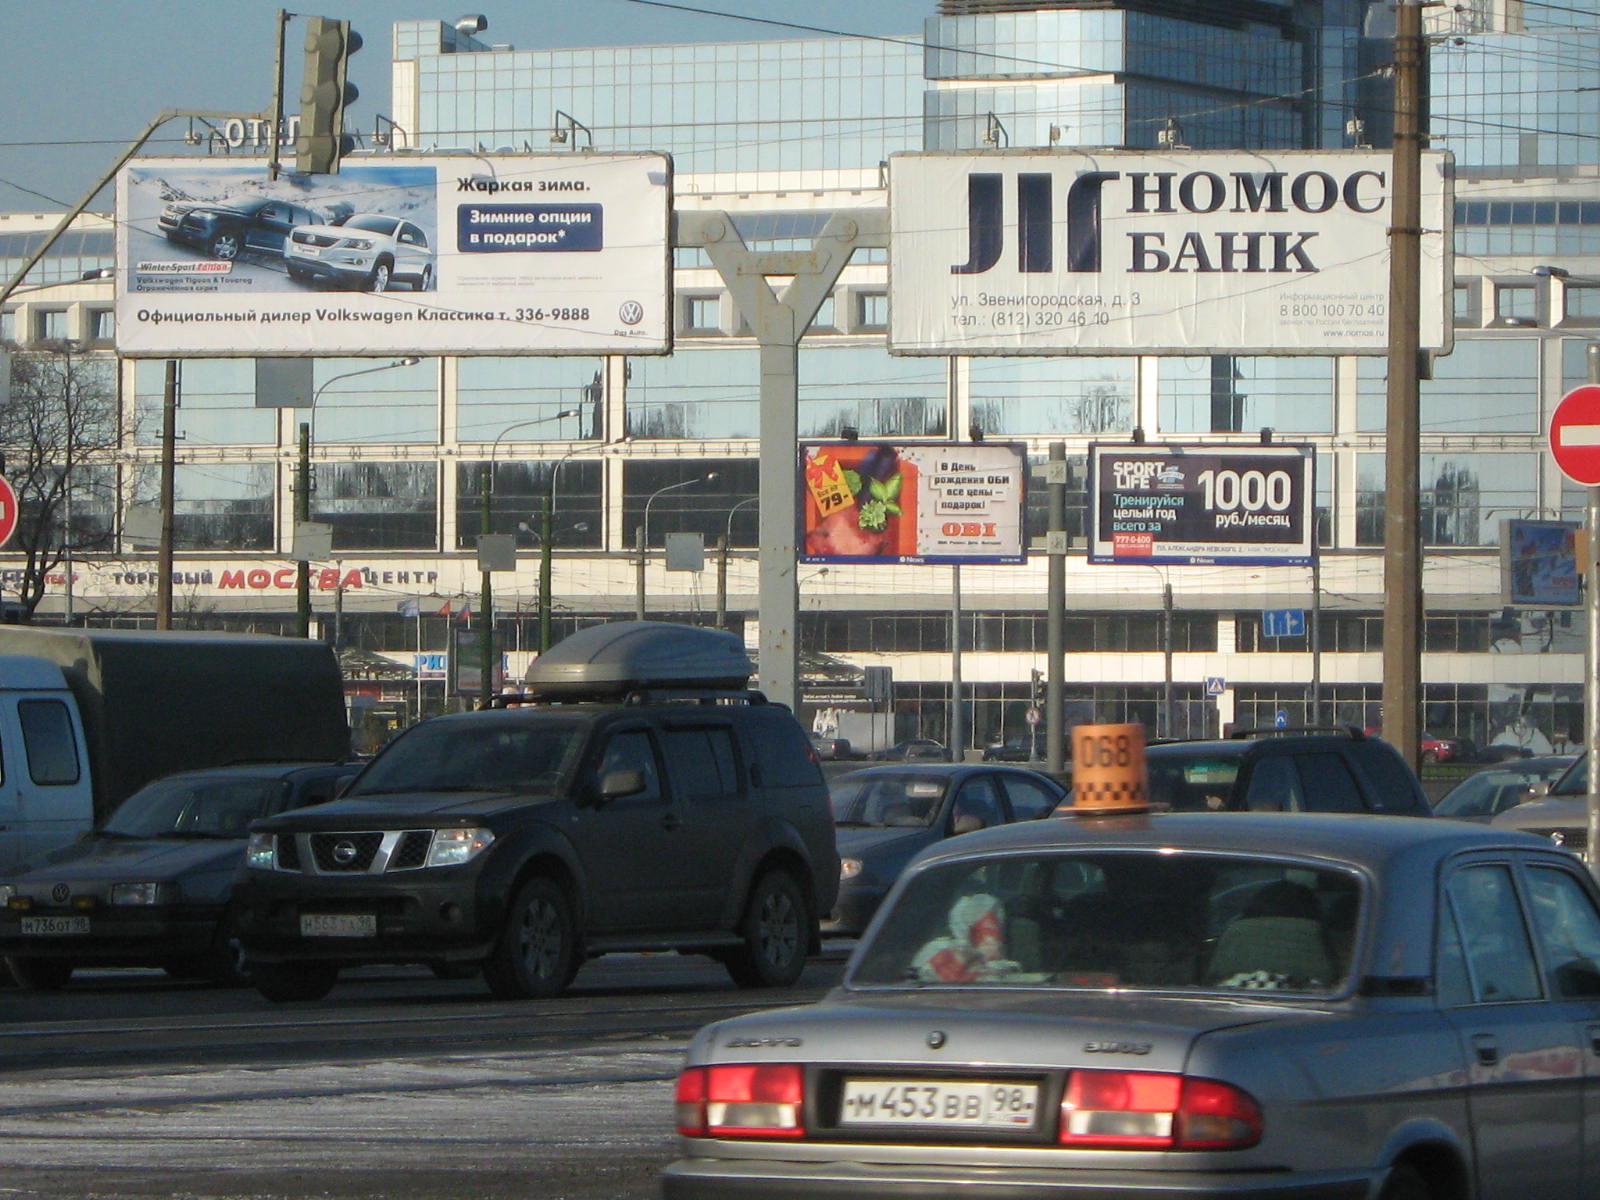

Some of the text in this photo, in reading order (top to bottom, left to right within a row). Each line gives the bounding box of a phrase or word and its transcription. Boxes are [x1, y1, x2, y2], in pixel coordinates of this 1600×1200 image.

[456, 178, 591, 195] Жаркая зима.
[1126, 171, 1386, 214] НОМОС
[470, 209, 592, 225] Зимние опции
[470, 233, 479, 243] в
[1126, 231, 1321, 273] БАНК
[951, 292, 1141, 311] ул. Звенигородская, д. 3
[137, 308, 590, 324] Официальный дилер Volkswagen Классика т. 336-9888
[1280, 304, 1385, 316] 8 800 100 70 40
[991, 312, 1031, 329] (812)
[1035, 312, 1063, 325] 320
[1068, 312, 1086, 325] 46
[1094, 312, 1110, 325] 10
[941, 462, 976, 473] В День
[1113, 461, 1165, 476] SPORT
[934, 476, 1010, 486] рождения ОБИ
[1116, 475, 1150, 489] LIFE
[946, 488, 965, 496] все
[967, 488, 993, 498] цены
[1197, 470, 1292, 511] 1000
[941, 501, 986, 511] подарок!
[1113, 493, 1184, 507] Тренируйся
[1113, 507, 1177, 521] целый год
[1215, 511, 1290, 528] руб./месяц
[942, 522, 997, 537] OBI
[1113, 522, 1162, 532] всего за
[113, 569, 213, 585] ТОРГВЫЙ
[365, 571, 438, 585] ЦЕНТР
[993, 1087, 1024, 1112] 98
